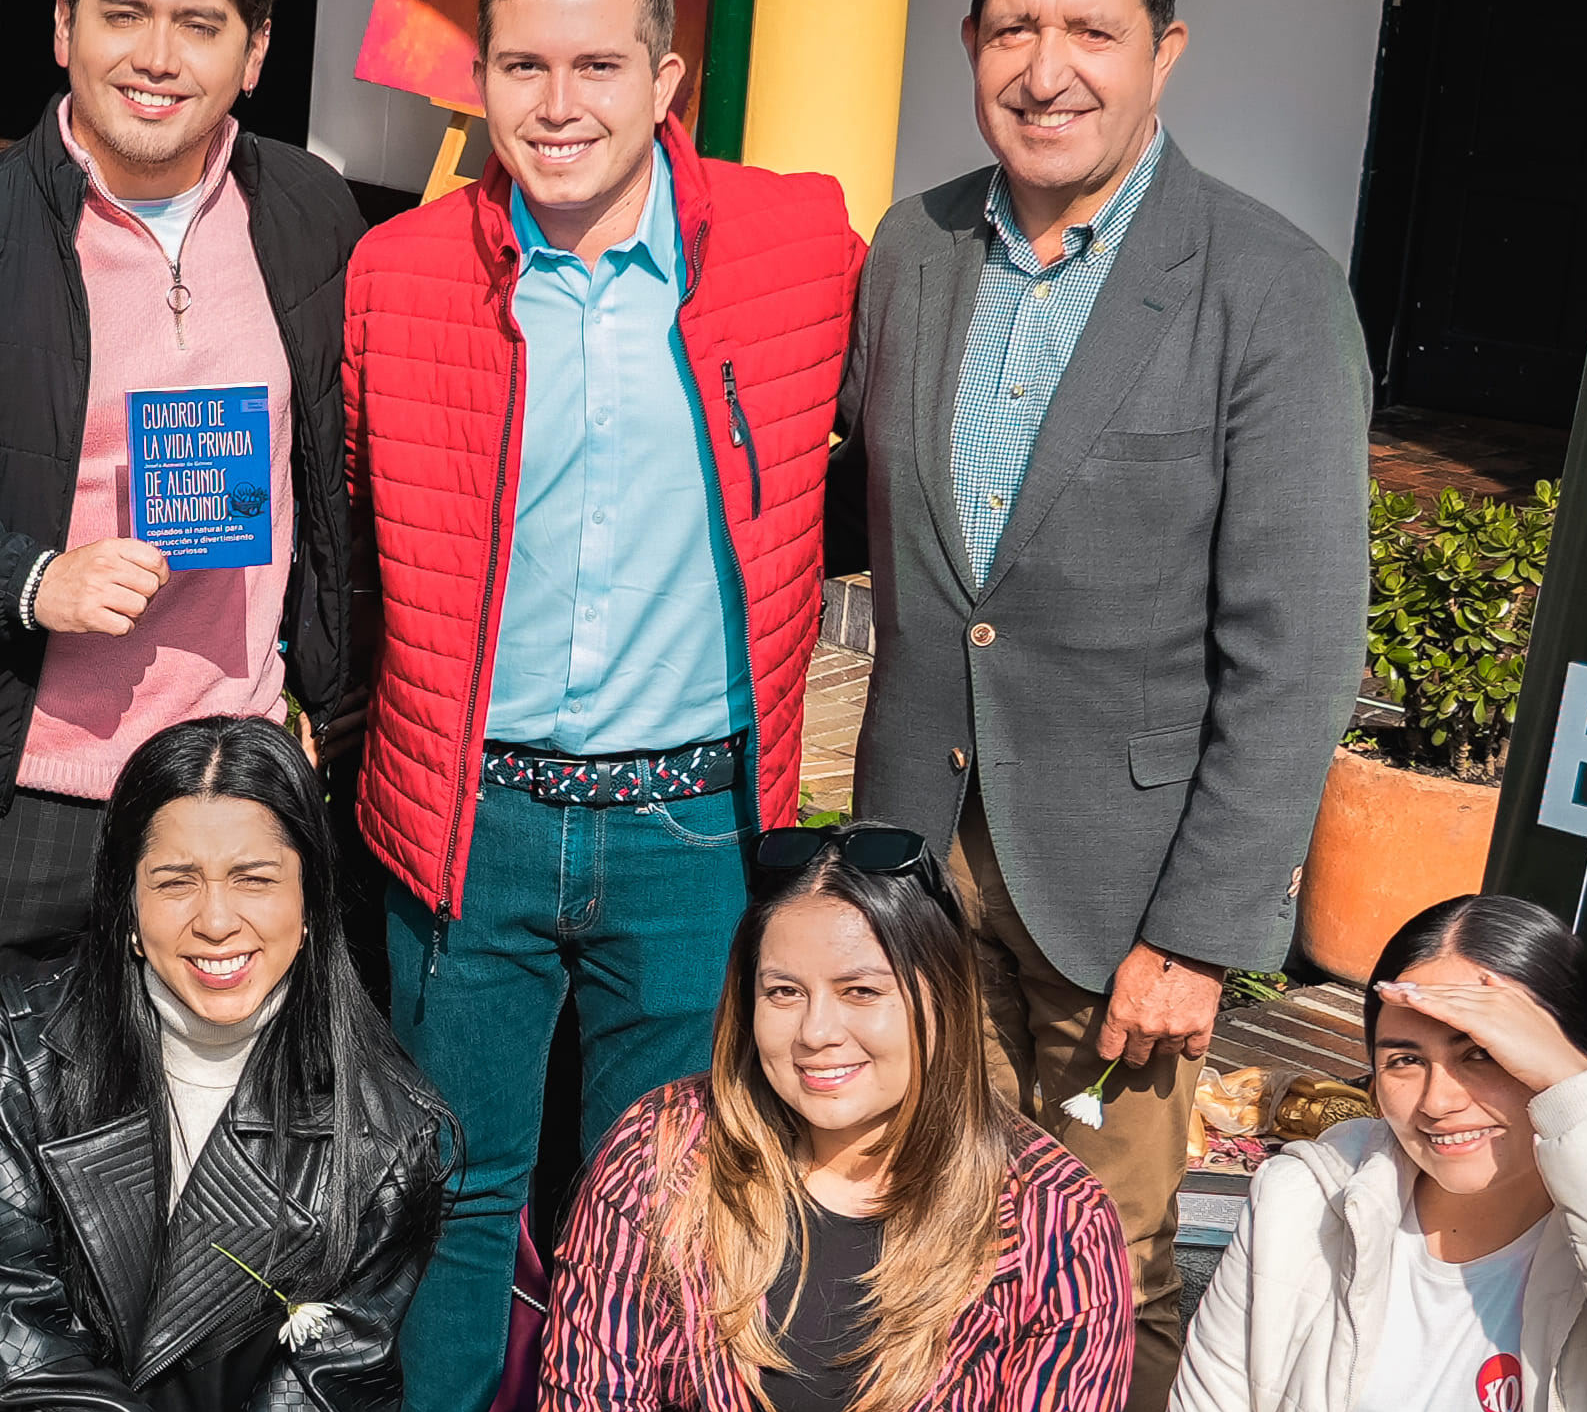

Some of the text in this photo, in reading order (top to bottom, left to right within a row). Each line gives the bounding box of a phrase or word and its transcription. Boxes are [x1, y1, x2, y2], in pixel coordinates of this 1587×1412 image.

[143, 400, 225, 429] CUADROS DE
[143, 430, 253, 461] LA VIDA PRIVADA
[145, 468, 226, 498] DE ALGUNOS
[146, 494, 232, 524] GRANADINOS,
[147, 527, 183, 537] copiados
[194, 525, 223, 535] natural
[225, 524, 243, 534] para
[193, 537, 199, 545] y
[200, 533, 254, 544] divertimiento
[173, 547, 208, 557] curiosos
